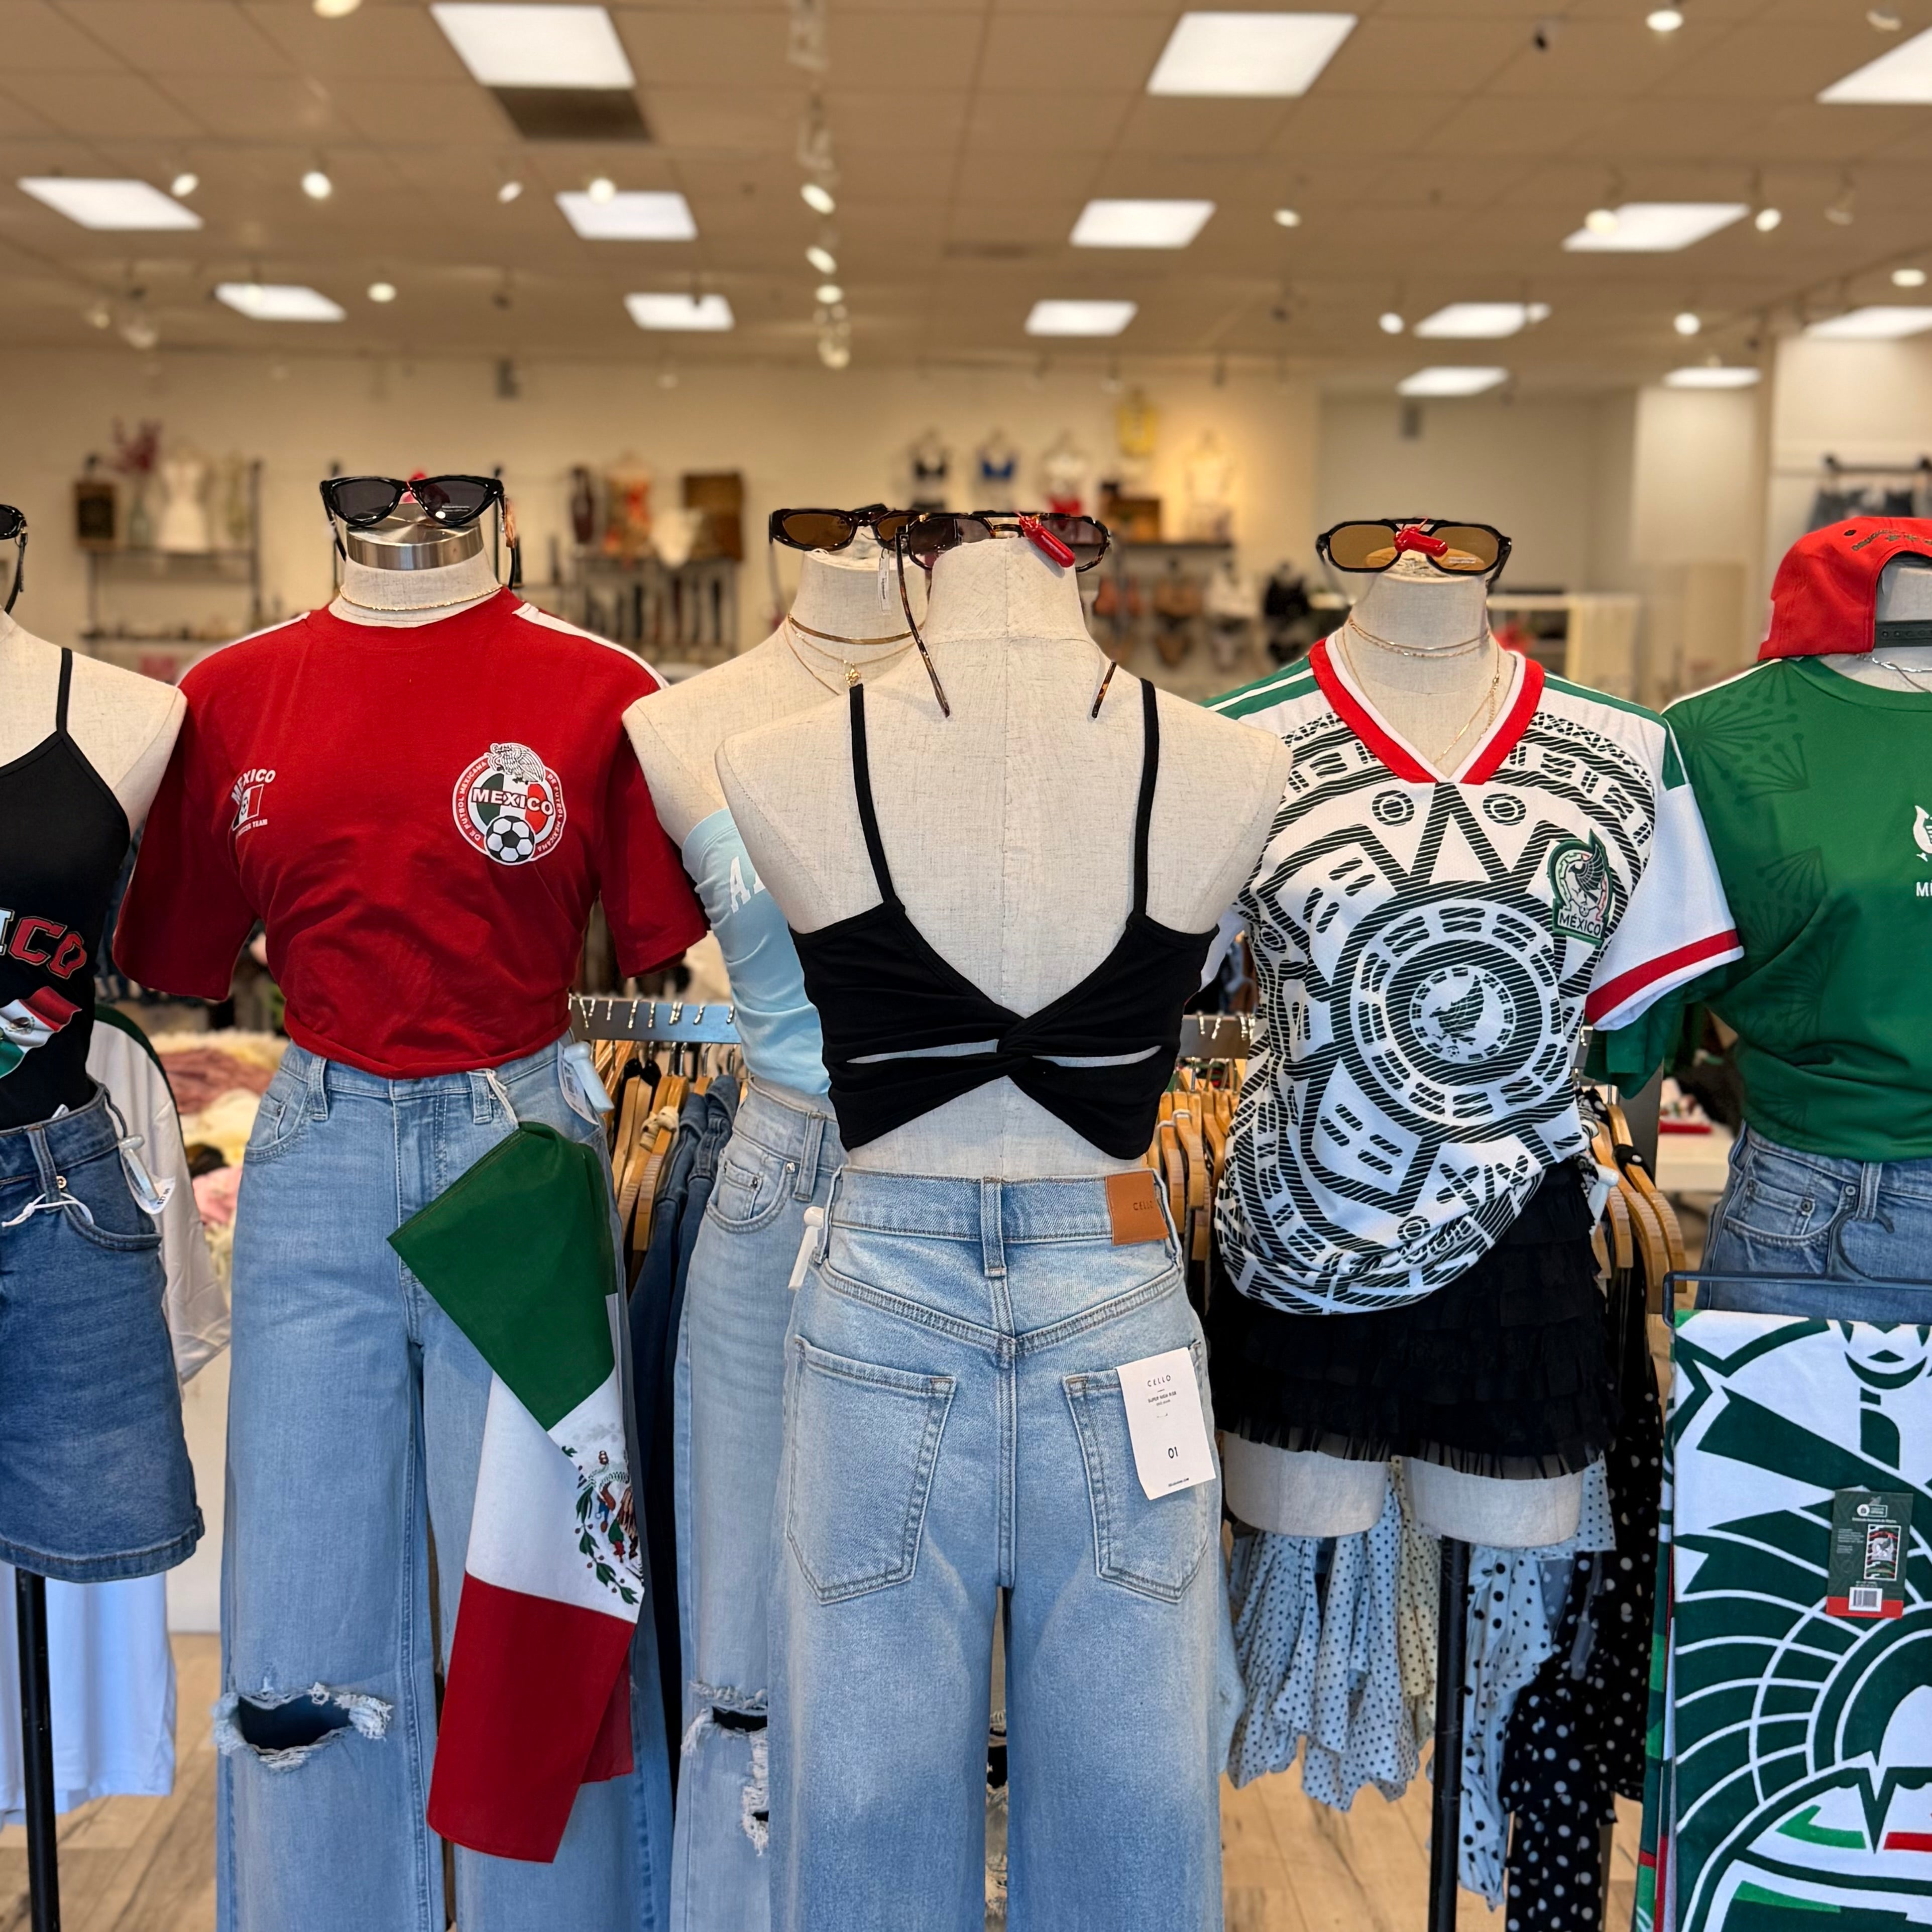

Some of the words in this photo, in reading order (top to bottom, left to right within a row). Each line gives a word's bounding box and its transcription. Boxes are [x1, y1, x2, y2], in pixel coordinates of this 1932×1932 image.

[231, 769, 276, 806] MEXICO
[459, 761, 487, 794] MEXICANA
[458, 796, 471, 829] FUTBOL
[472, 788, 554, 816] MEXICO
[470, 830, 481, 841] DE
[1916, 881, 1932, 897] M
[1559, 913, 1602, 937] MÉXICO
[1147, 1375, 1171, 1387] CELLO
[1168, 1446, 1178, 1458] 01
